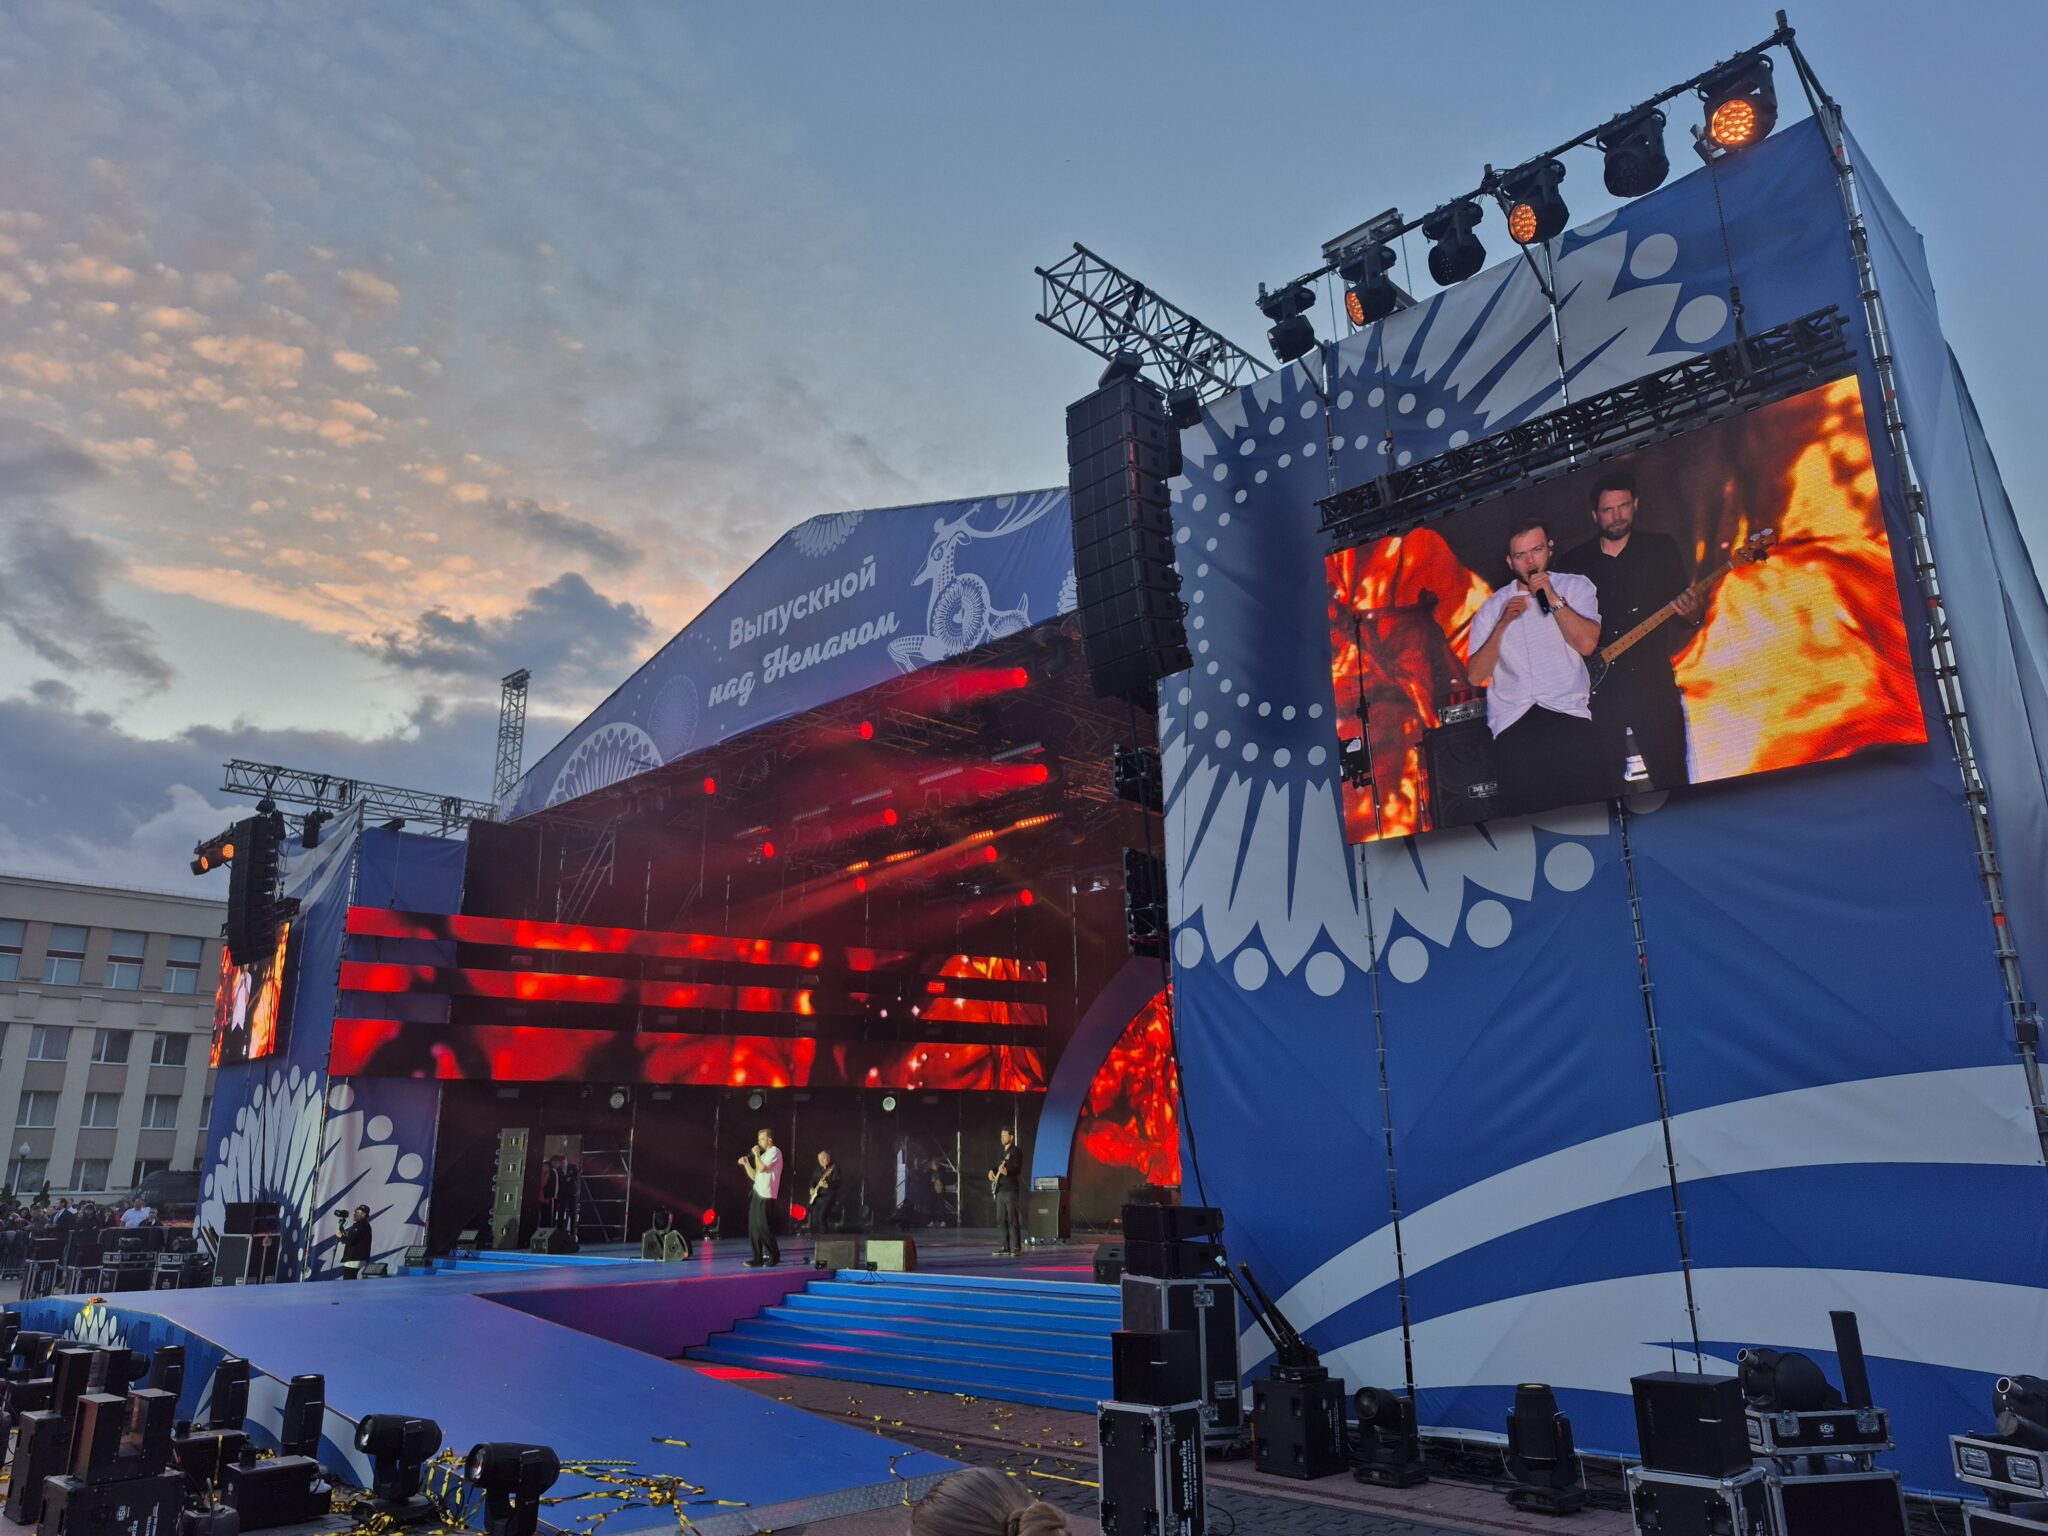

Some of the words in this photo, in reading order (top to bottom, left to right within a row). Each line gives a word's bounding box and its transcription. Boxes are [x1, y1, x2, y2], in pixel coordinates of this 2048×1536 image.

[729, 554, 876, 649] Выпускной
[708, 671, 755, 707] над
[762, 611, 900, 684] Неманом
[1180, 1440, 1188, 1479] Fabrica
